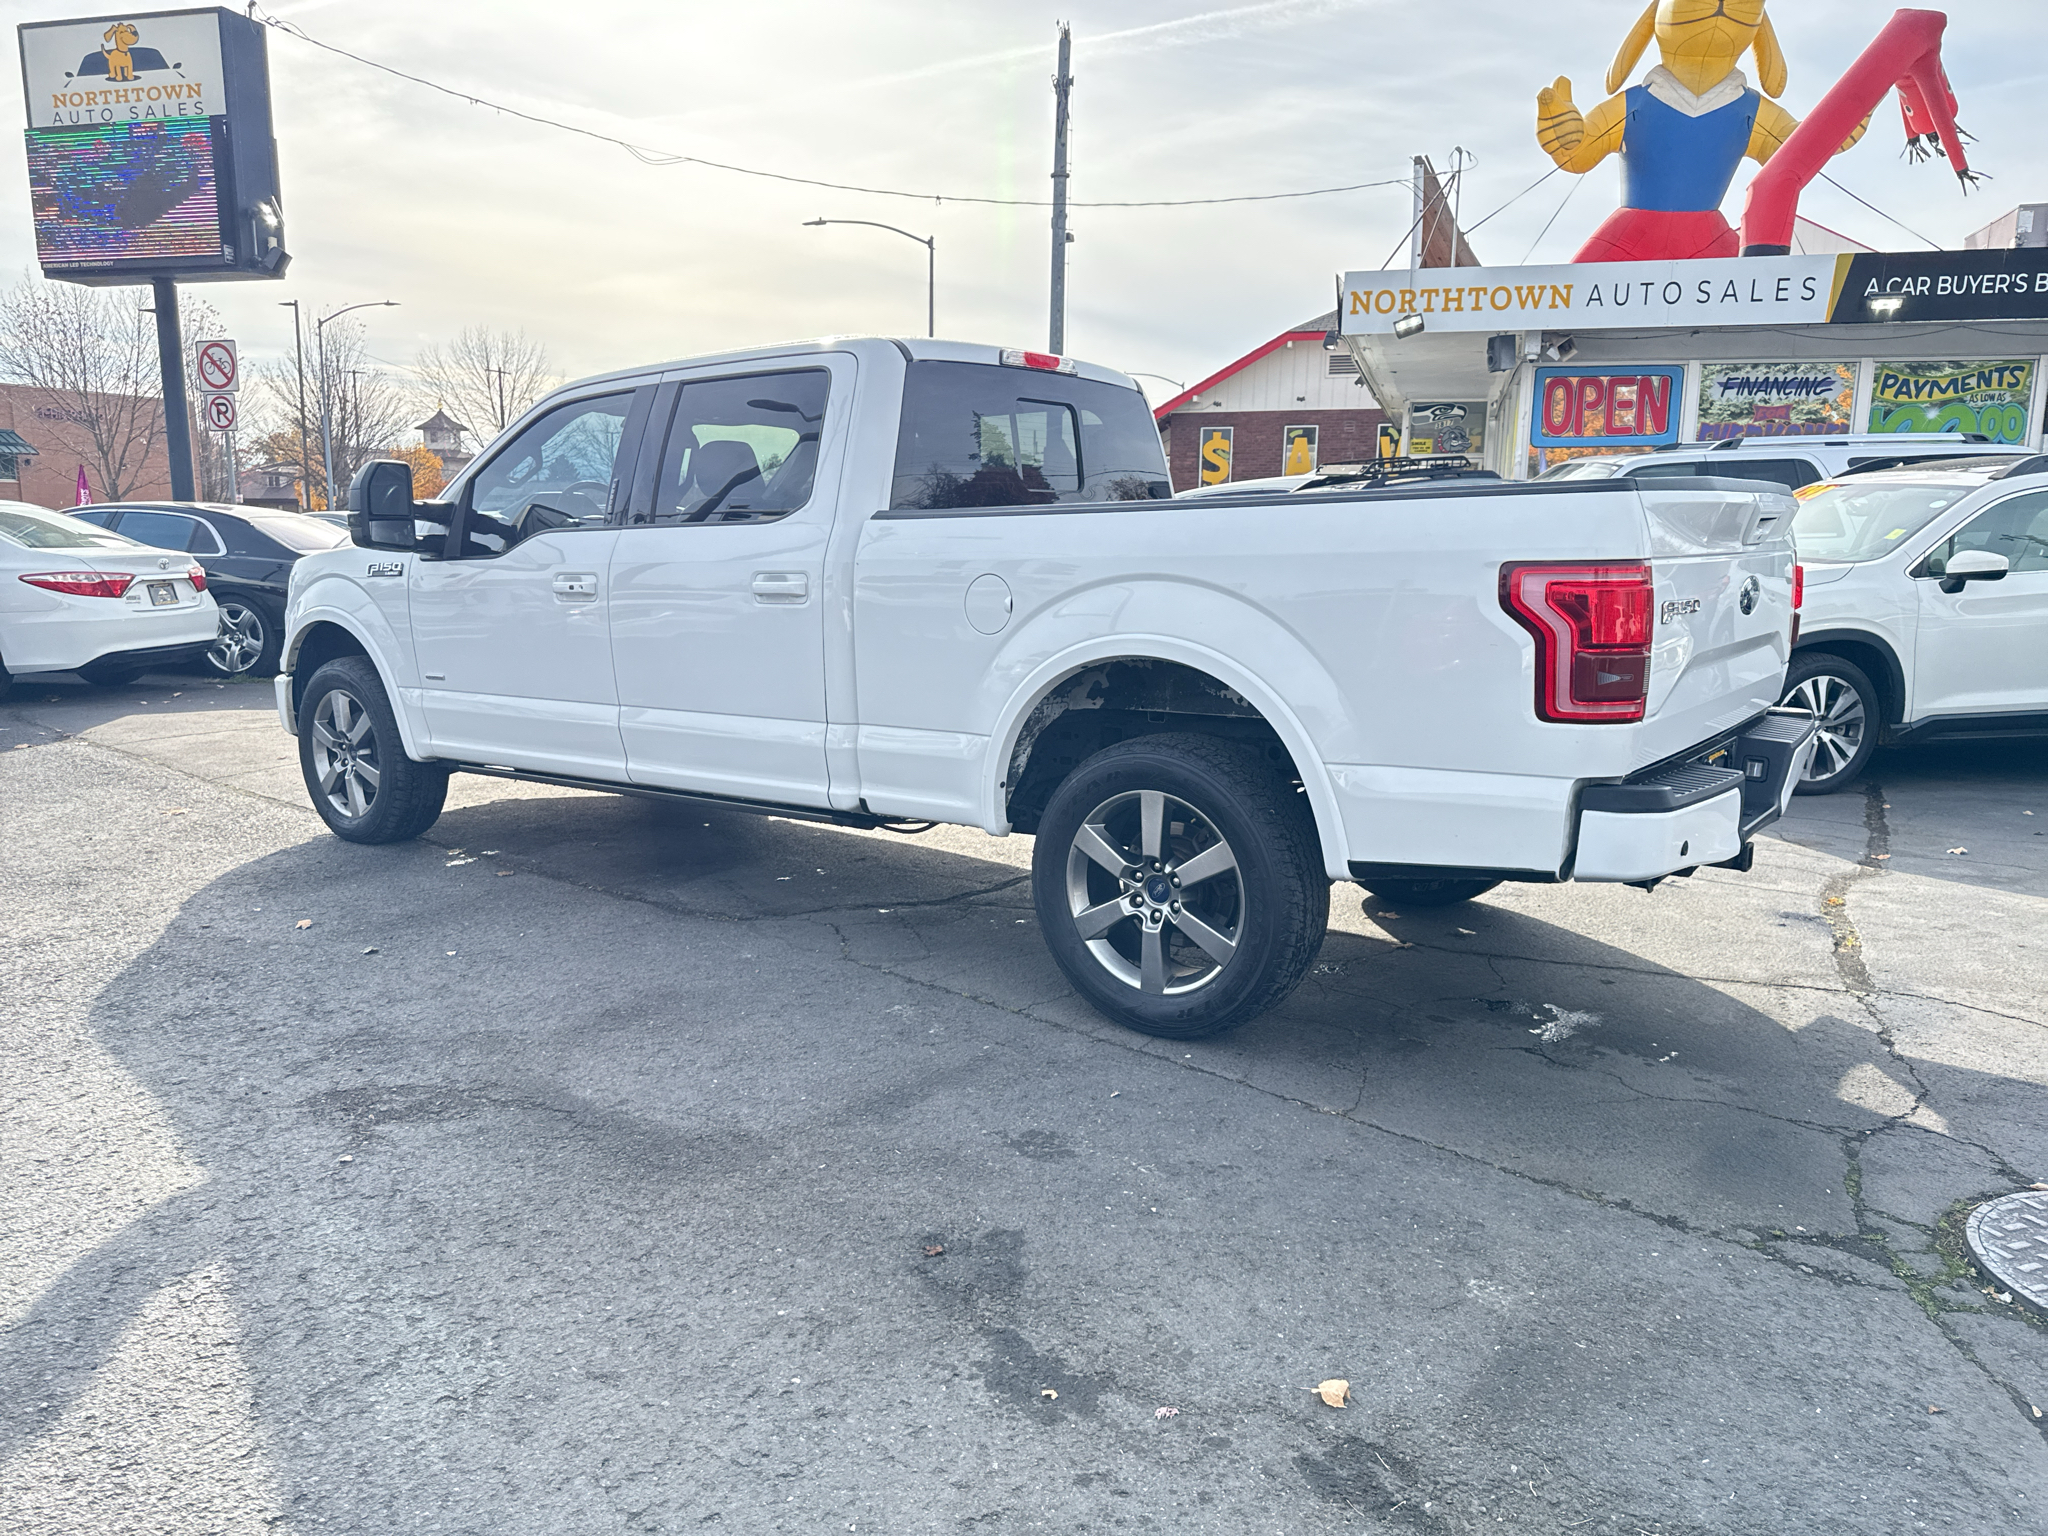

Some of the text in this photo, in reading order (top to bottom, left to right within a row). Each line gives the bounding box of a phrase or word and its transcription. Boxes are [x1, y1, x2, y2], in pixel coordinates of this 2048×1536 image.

[52, 83, 202, 109] NORTHTOWN
[53, 101, 204, 125] AUTO SALES
[1350, 276, 1817, 316] NORTHTOWN AUTO SALES
[1864, 277, 1879, 297] A
[1886, 276, 1930, 296] CAR
[1937, 273, 2028, 295] BUYER'S
[1720, 376, 1833, 398] FINANCING
[1879, 365, 2026, 399] PAYMENTS
[1542, 376, 1671, 437] OPEN
[1968, 392, 2007, 403] AS LOW AS
[216, 402, 229, 423] P
[1758, 408, 1787, 420] FOR
